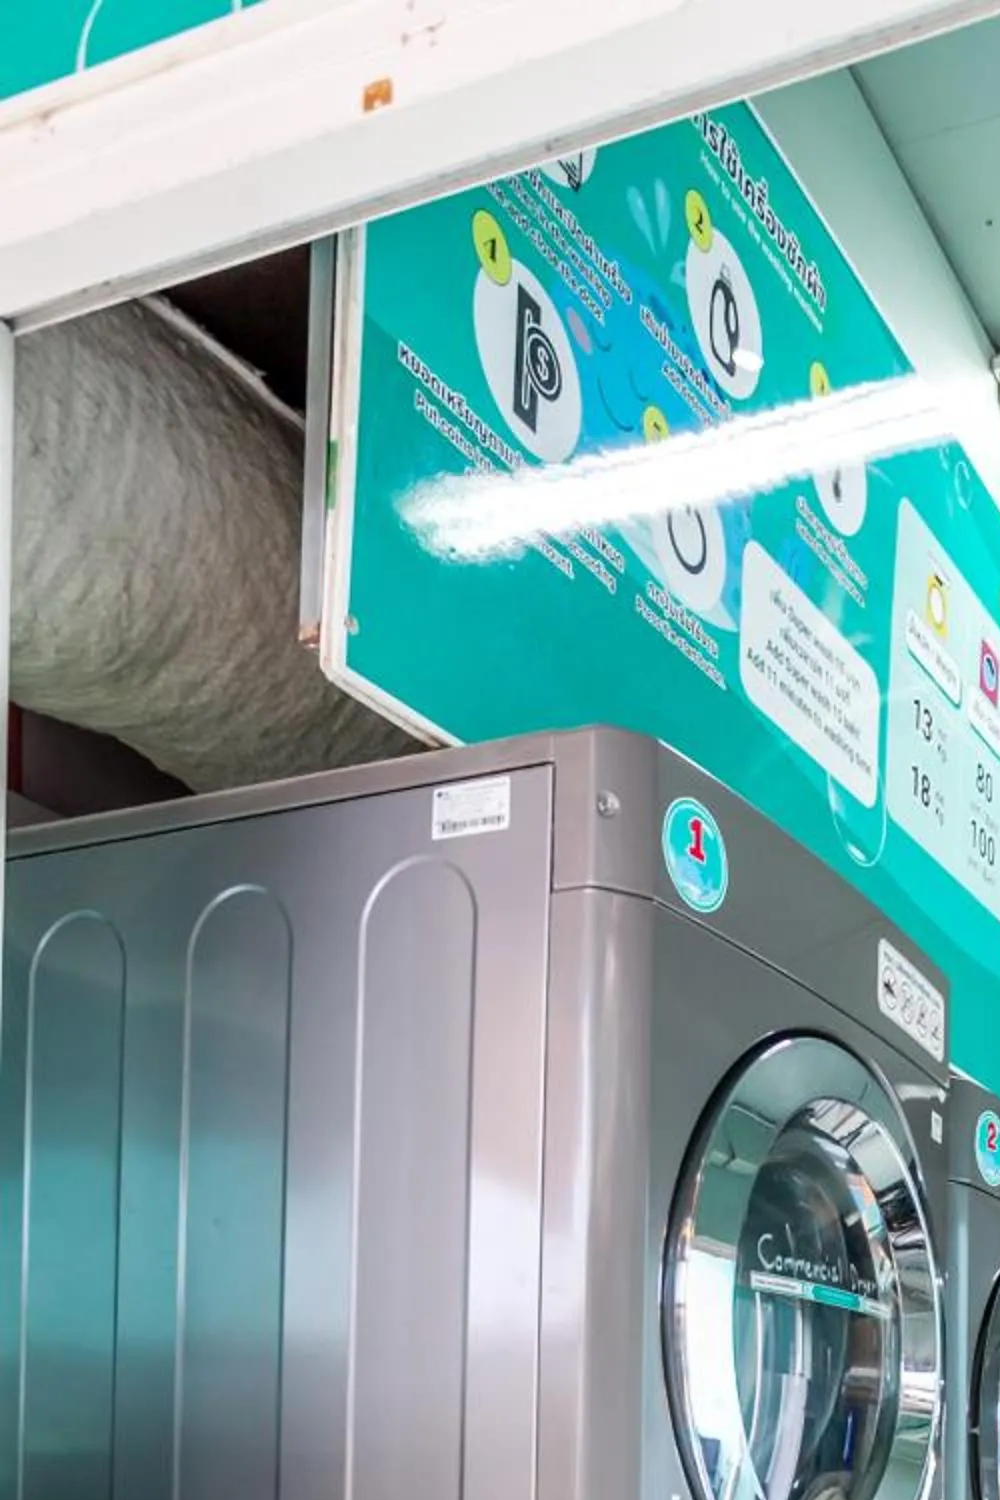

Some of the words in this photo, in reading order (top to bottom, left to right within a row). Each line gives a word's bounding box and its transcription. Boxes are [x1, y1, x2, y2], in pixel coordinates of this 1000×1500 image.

[694, 211, 705, 236] 2
[914, 700, 933, 741] 13
[912, 766, 931, 807] 18
[976, 763, 993, 803] 80
[688, 818, 706, 863] 1
[971, 820, 995, 866] 100
[988, 1123, 997, 1151] 2
[757, 1231, 845, 1285] Commercial
